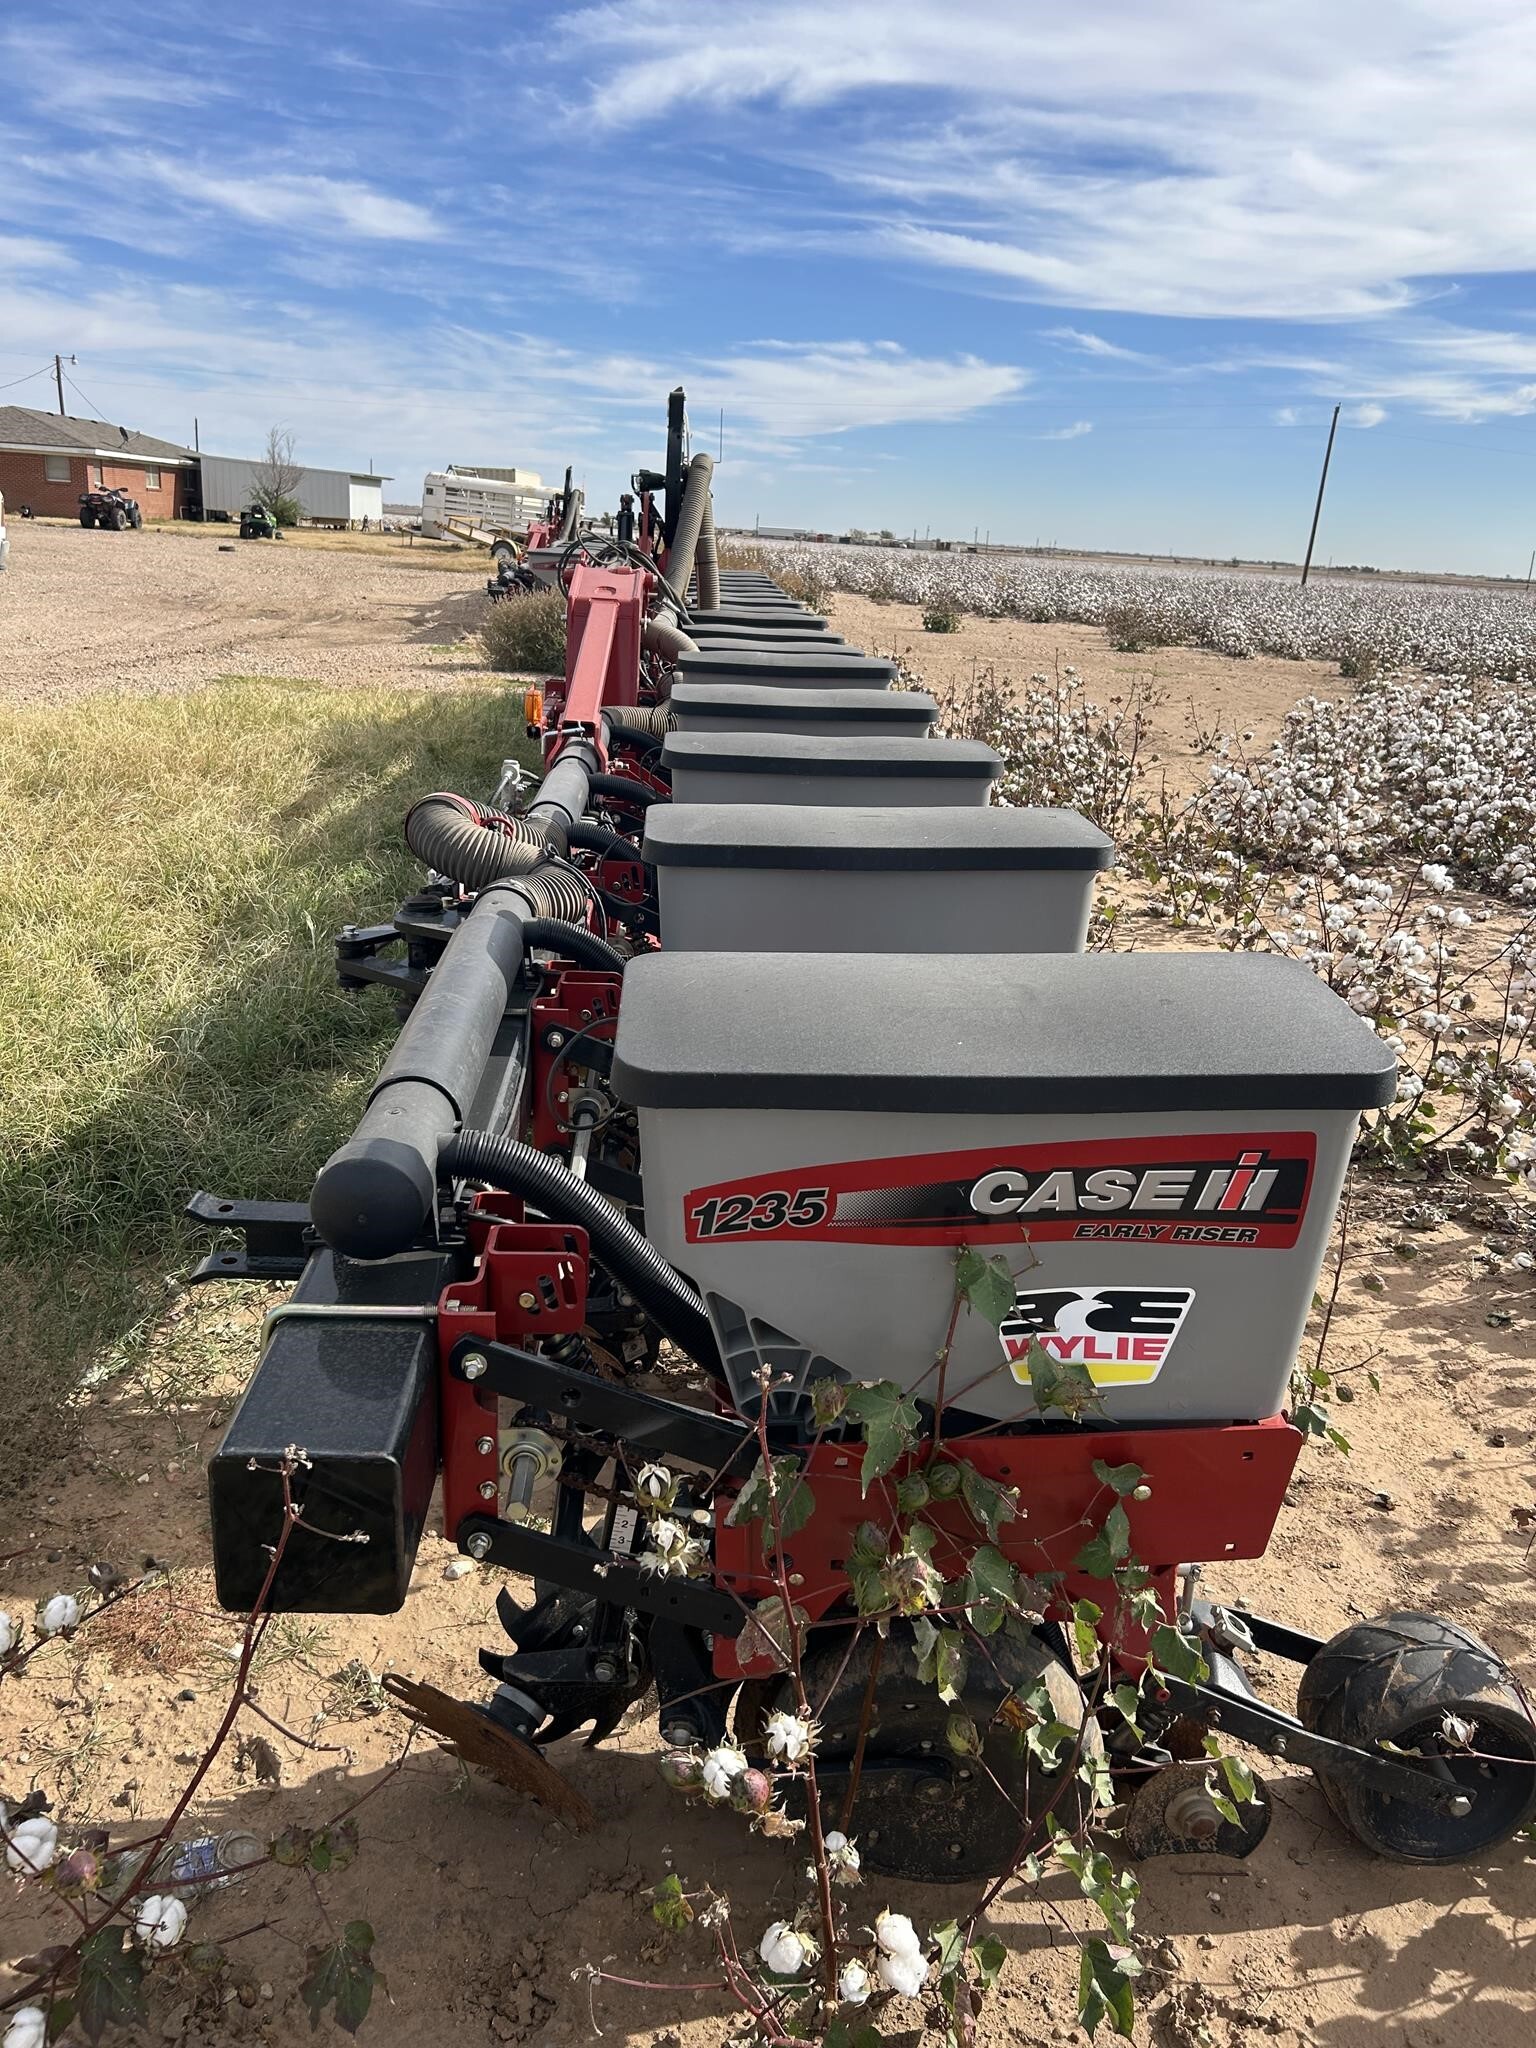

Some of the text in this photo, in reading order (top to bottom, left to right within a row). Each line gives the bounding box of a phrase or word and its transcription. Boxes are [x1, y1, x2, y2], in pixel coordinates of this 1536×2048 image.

[970, 1169, 1197, 1215] CASE
[691, 1187, 829, 1238] 1235
[1073, 1224, 1259, 1243] EARLY RISER
[1005, 1336, 1169, 1361] WYLIE
[621, 1520, 629, 1528] 2
[617, 1536, 625, 1544] 3
